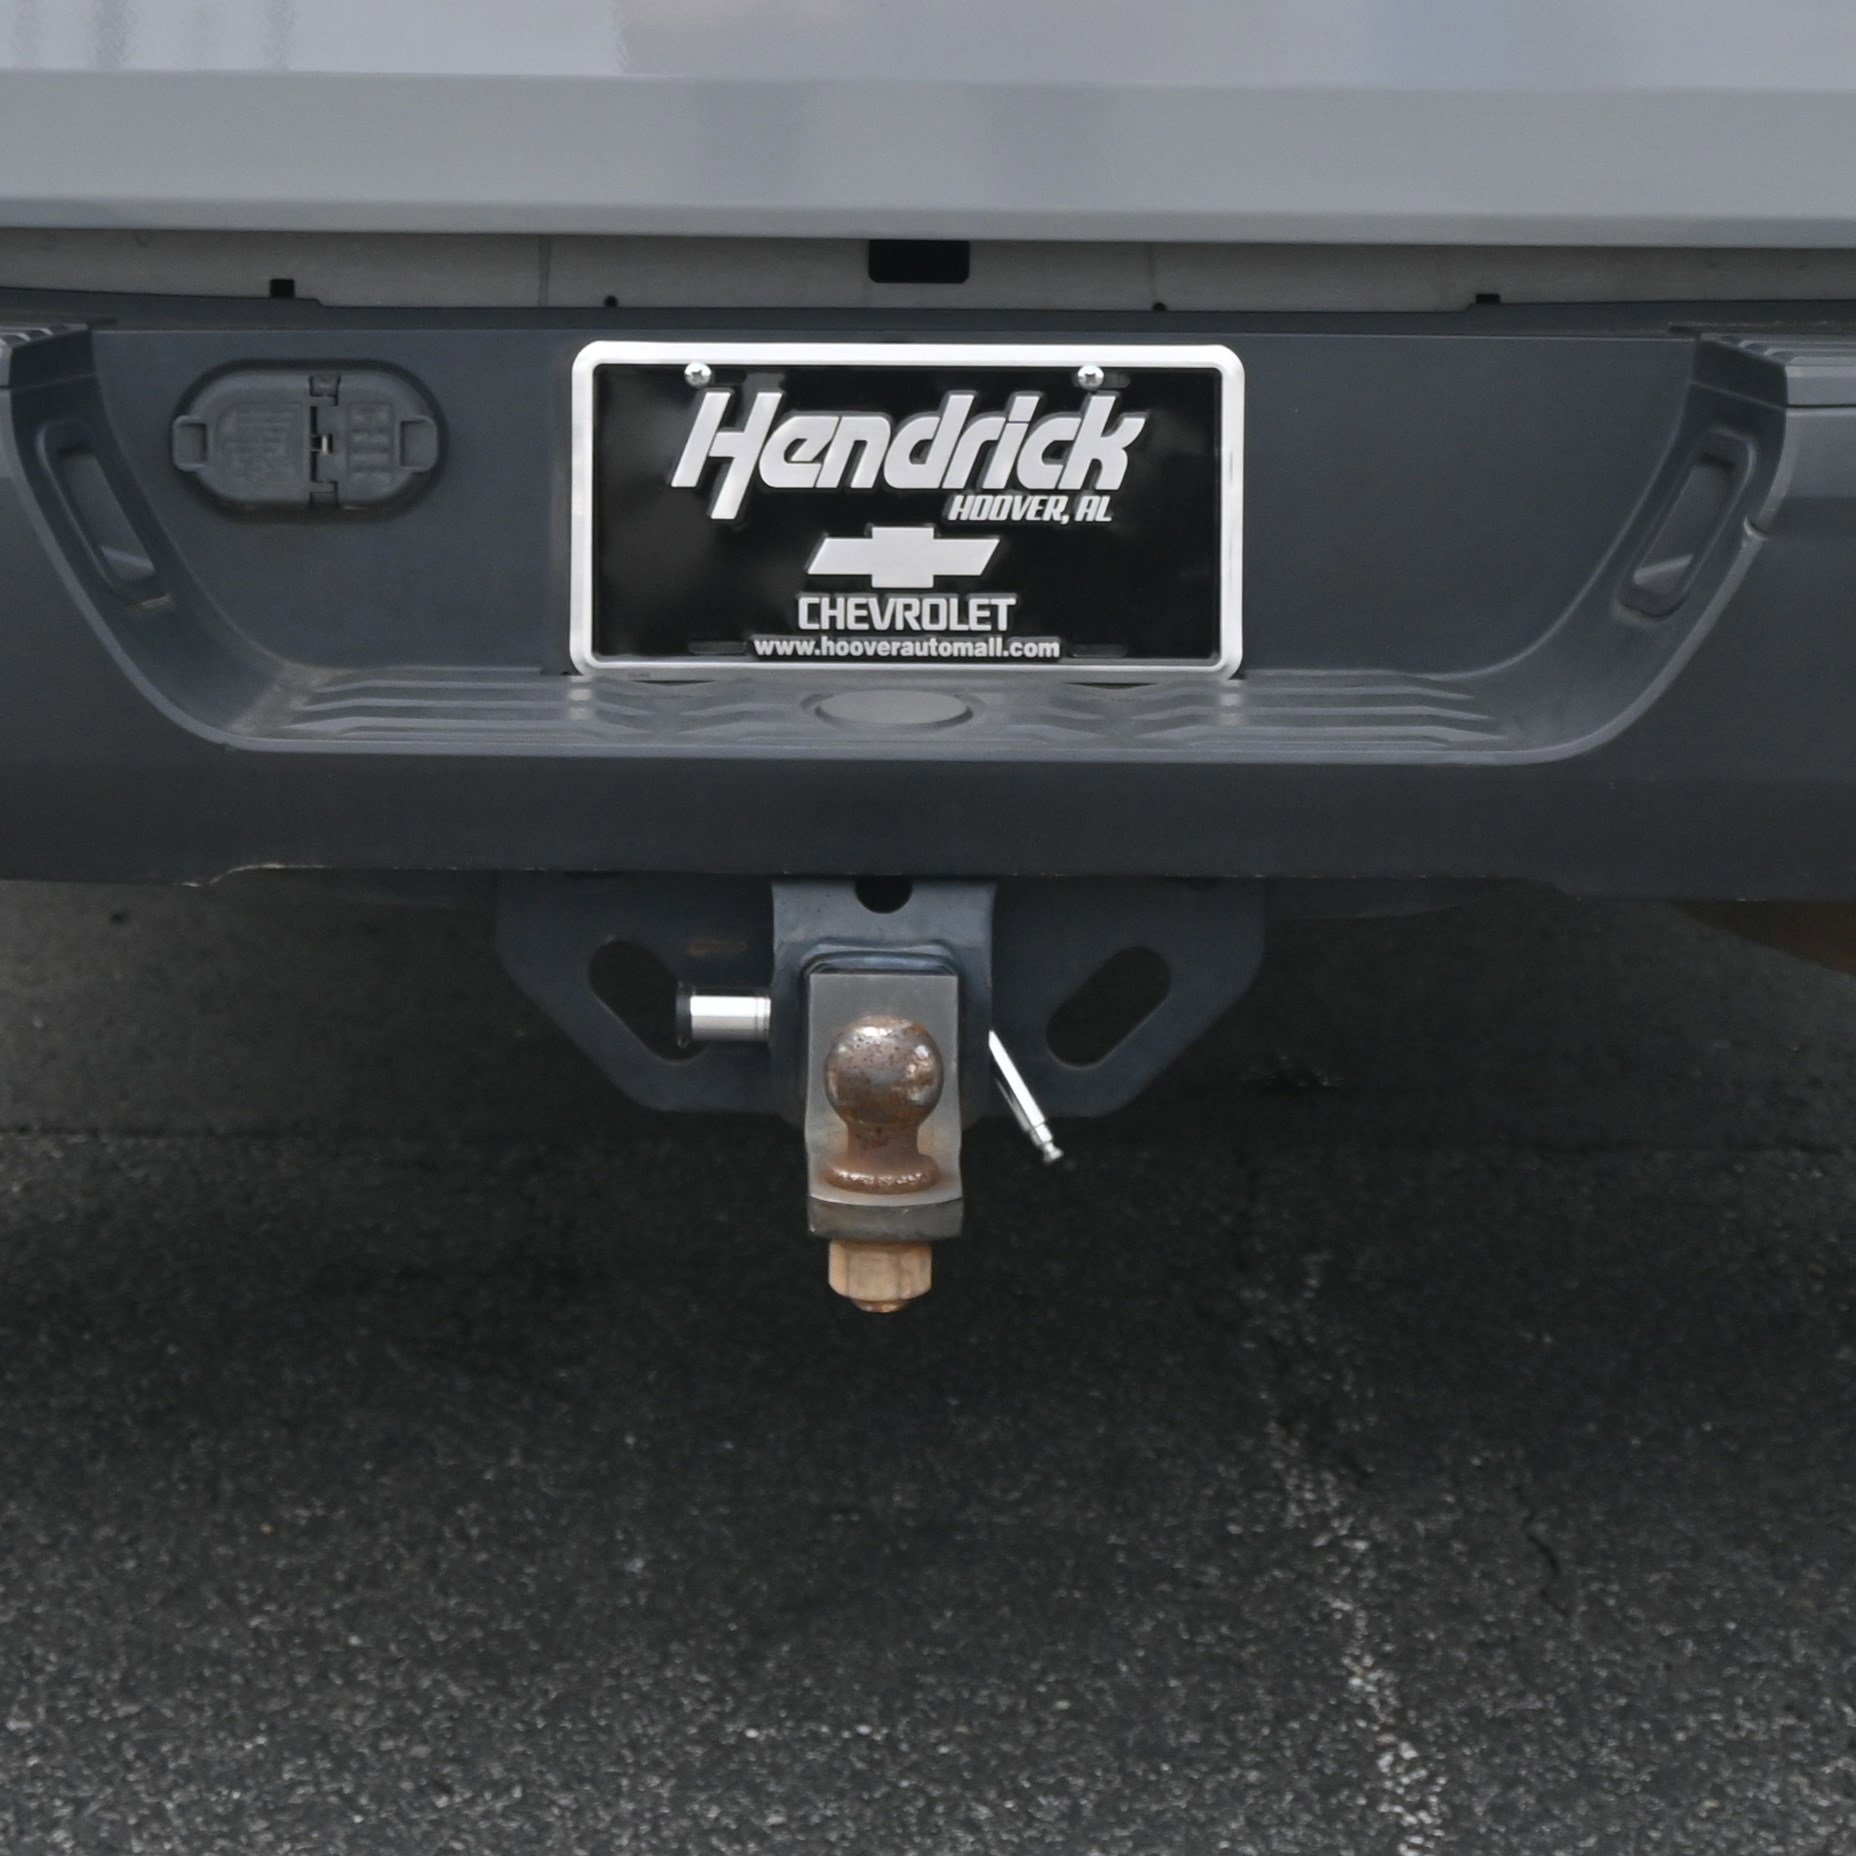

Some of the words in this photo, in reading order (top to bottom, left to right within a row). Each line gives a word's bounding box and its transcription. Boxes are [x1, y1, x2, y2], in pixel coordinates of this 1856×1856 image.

[671, 390, 1145, 520] Hendrick
[948, 494, 1068, 524] HOOVER,
[1075, 497, 1112, 523] AL
[799, 597, 1016, 631] CHEVROLET
[754, 637, 1060, 659] www.hooverautomall.com
